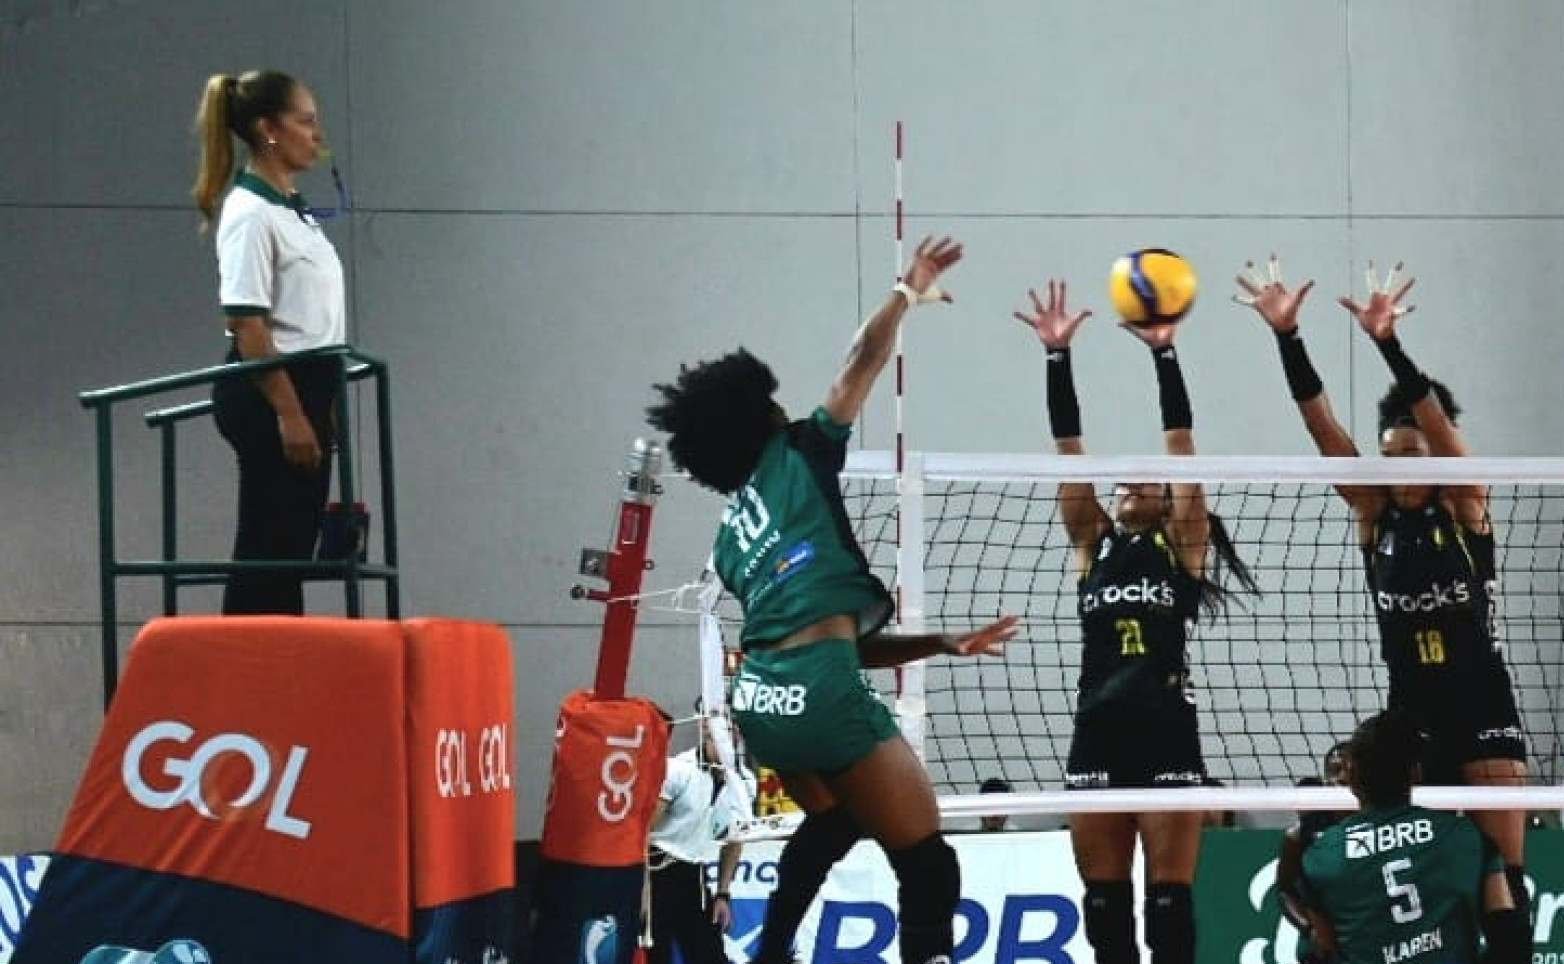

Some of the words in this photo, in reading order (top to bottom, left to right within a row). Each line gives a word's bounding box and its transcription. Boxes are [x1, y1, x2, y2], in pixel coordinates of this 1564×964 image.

[753, 684, 806, 716] BRB
[121, 721, 310, 838] GOL
[436, 729, 471, 798] GOL
[479, 722, 510, 793] GOL
[597, 724, 645, 823] GOL
[1377, 819, 1434, 851] BRB
[1382, 858, 1423, 923] 5
